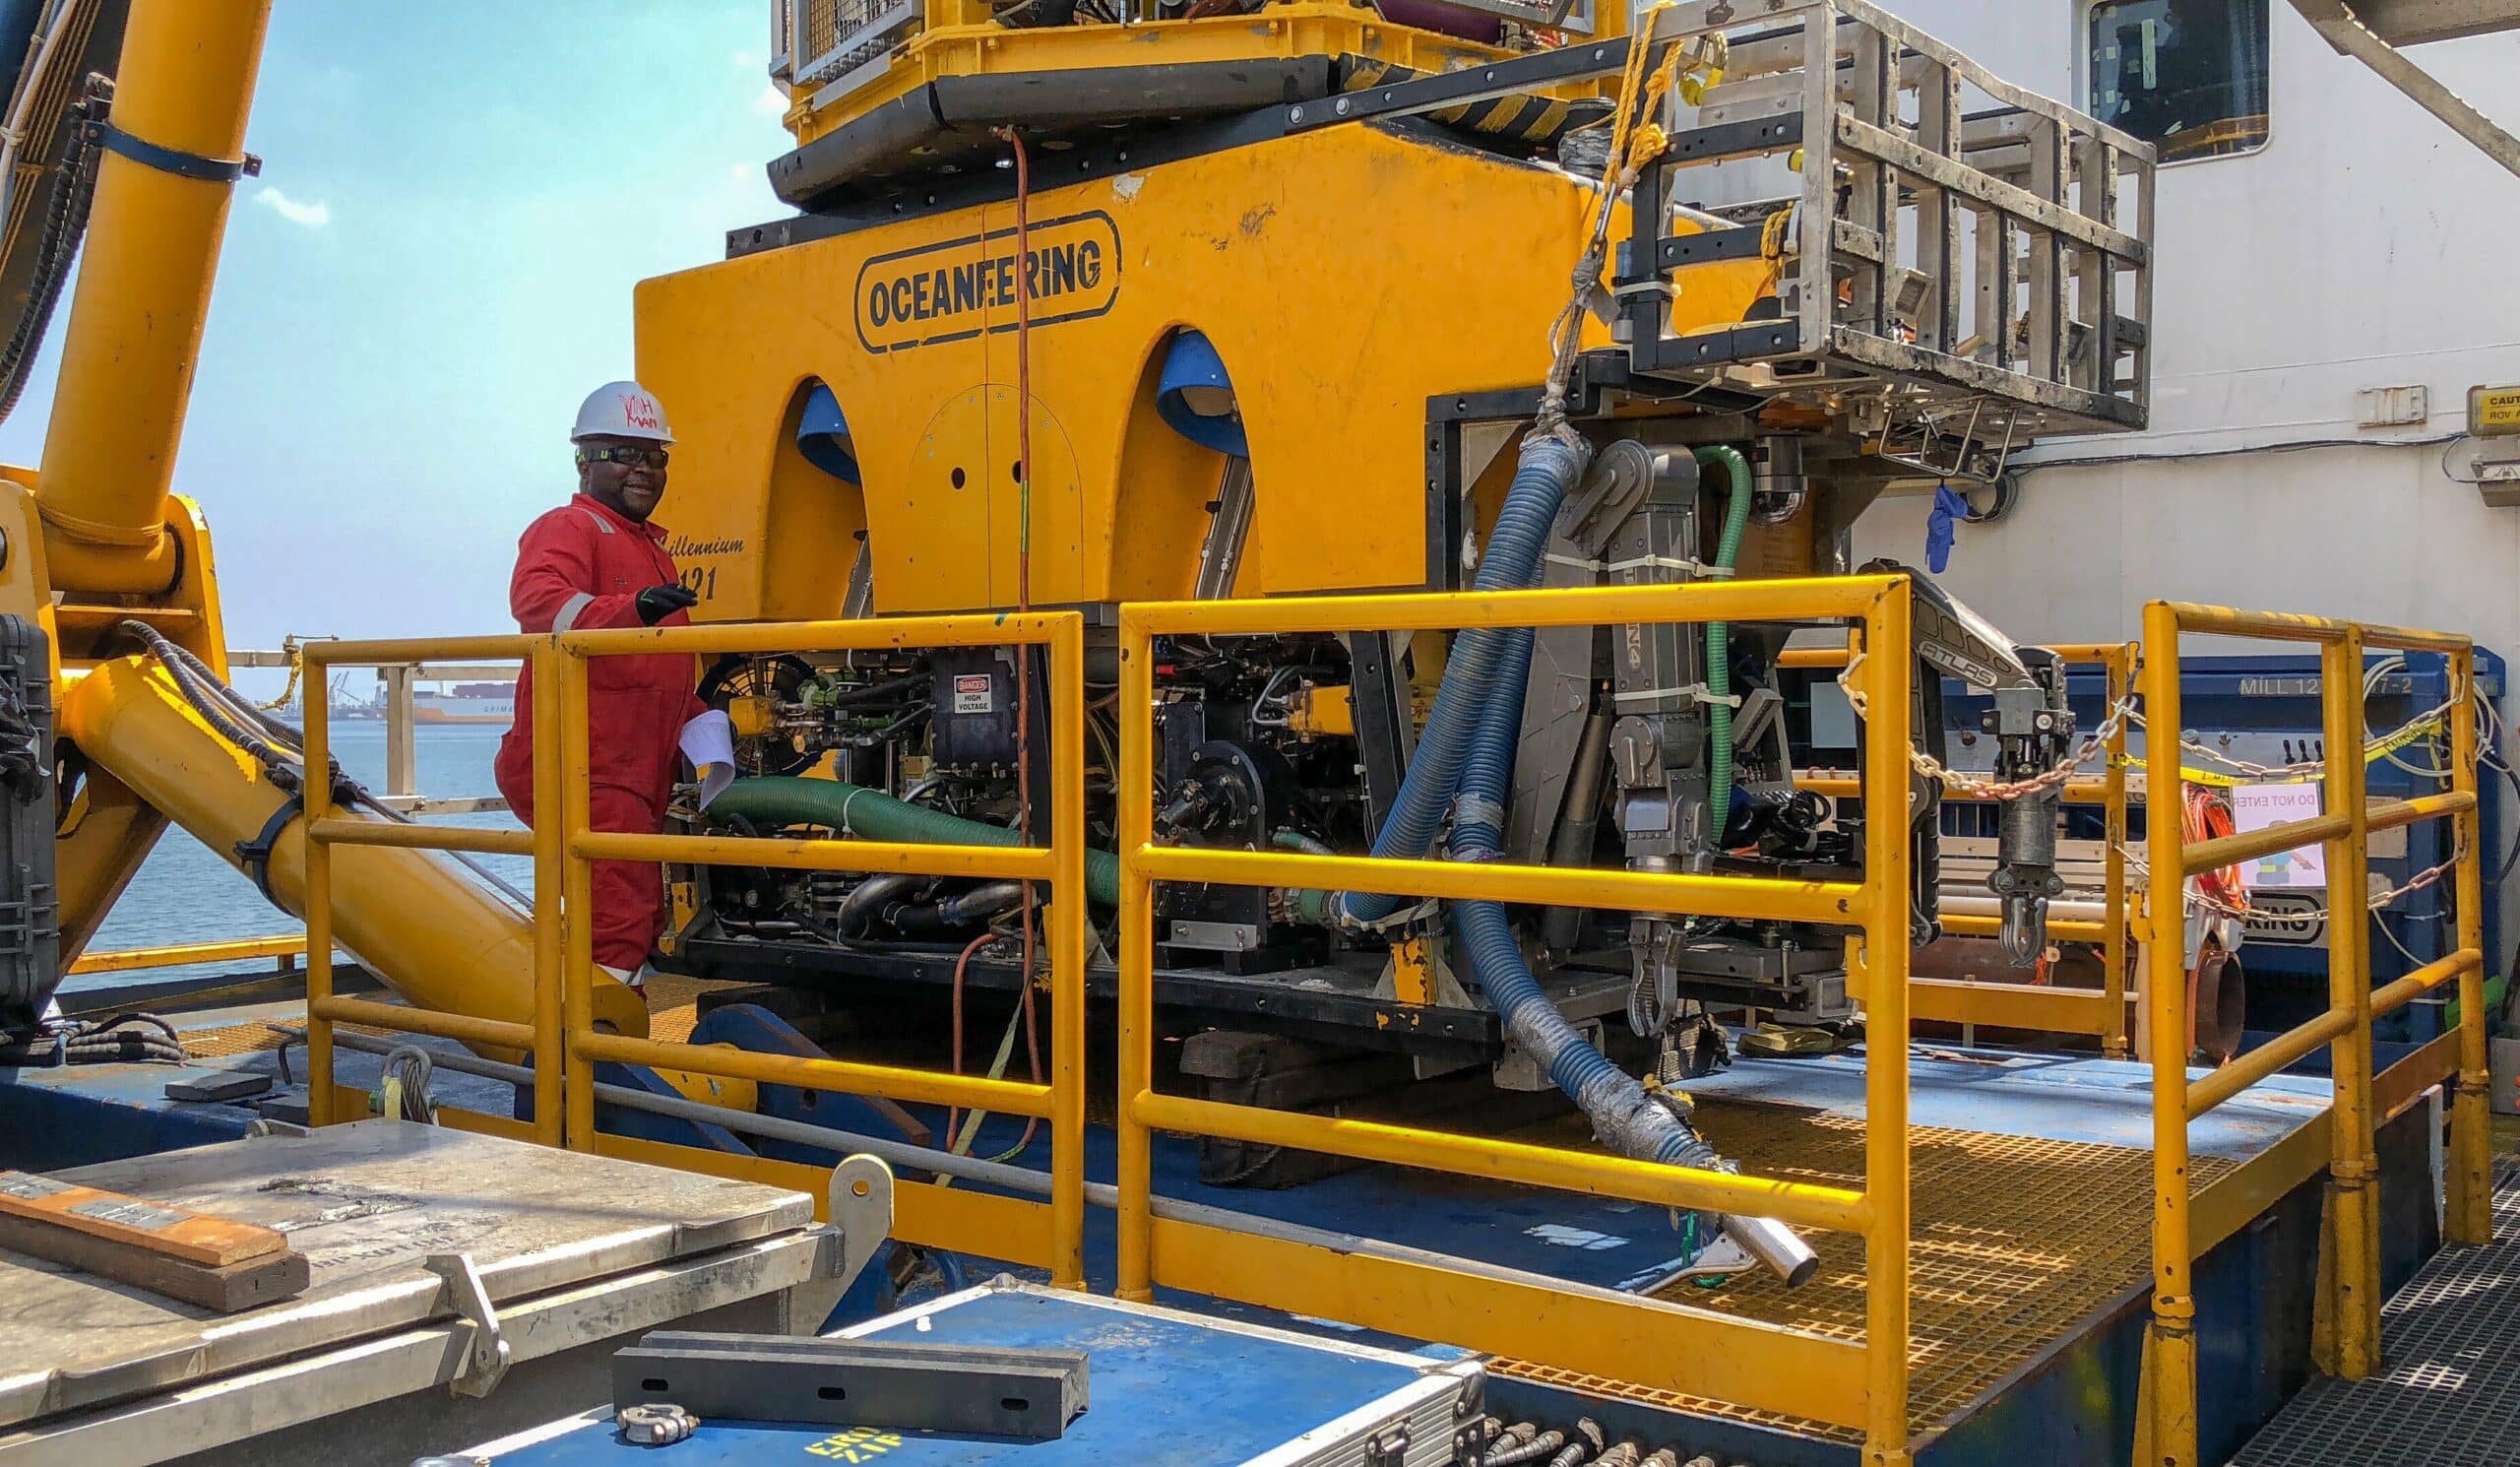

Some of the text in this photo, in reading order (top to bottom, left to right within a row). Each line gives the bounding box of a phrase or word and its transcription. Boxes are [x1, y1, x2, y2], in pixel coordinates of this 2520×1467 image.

[869, 239, 1101, 327] OCEANEERING
[2489, 411, 2511, 420] ROV
[1922, 643, 1995, 686] ATLAS
[2240, 679, 2288, 695] MILL
